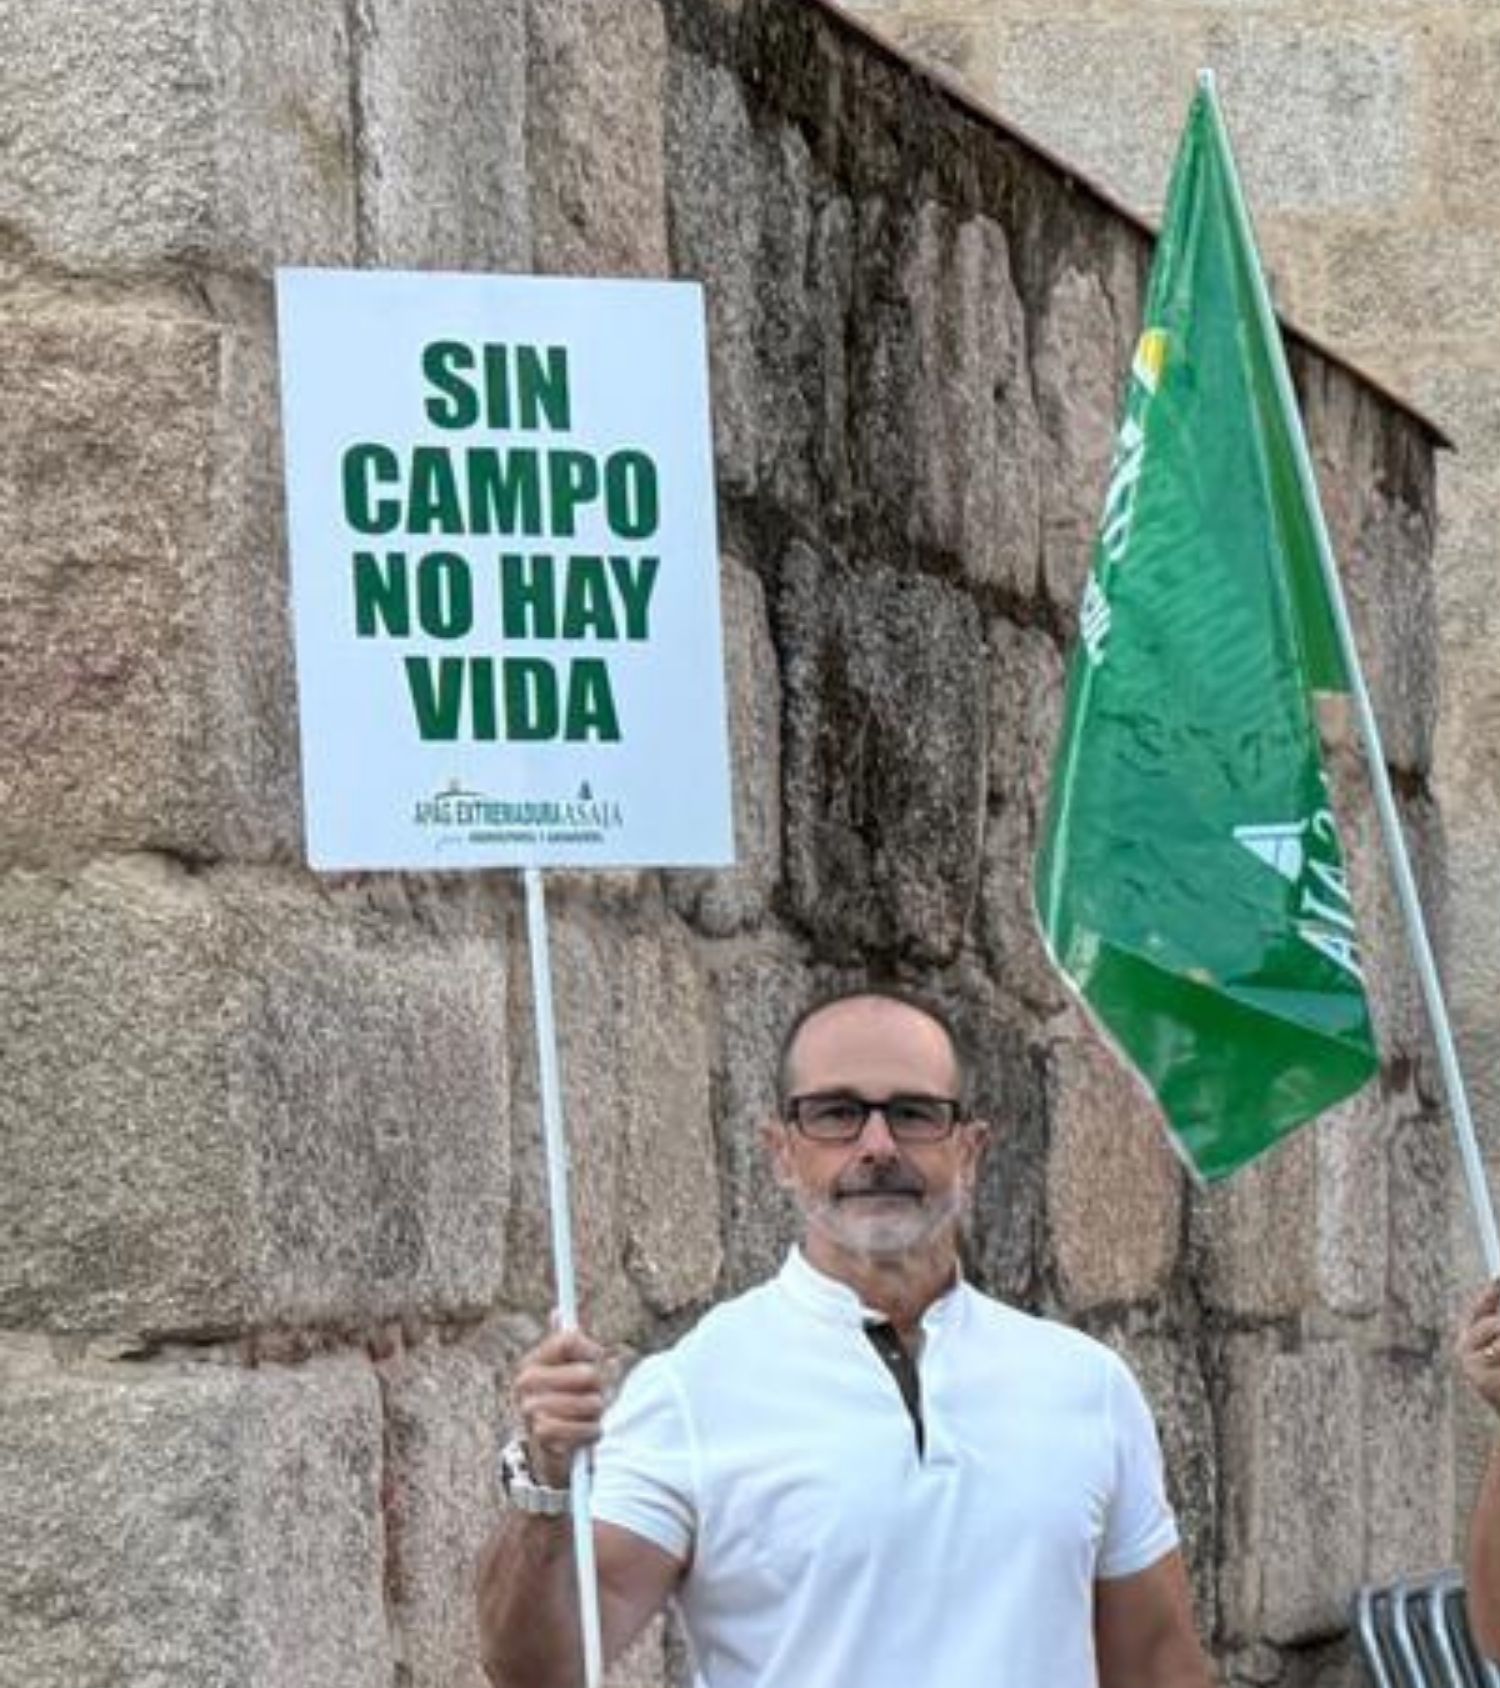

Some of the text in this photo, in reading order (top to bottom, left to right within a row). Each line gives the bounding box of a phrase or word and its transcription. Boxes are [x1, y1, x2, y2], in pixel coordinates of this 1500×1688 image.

[422, 340, 571, 430] SIN
[343, 443, 659, 540] CAMPO
[353, 551, 660, 640] NO HAY
[405, 657, 621, 741] VIDA
